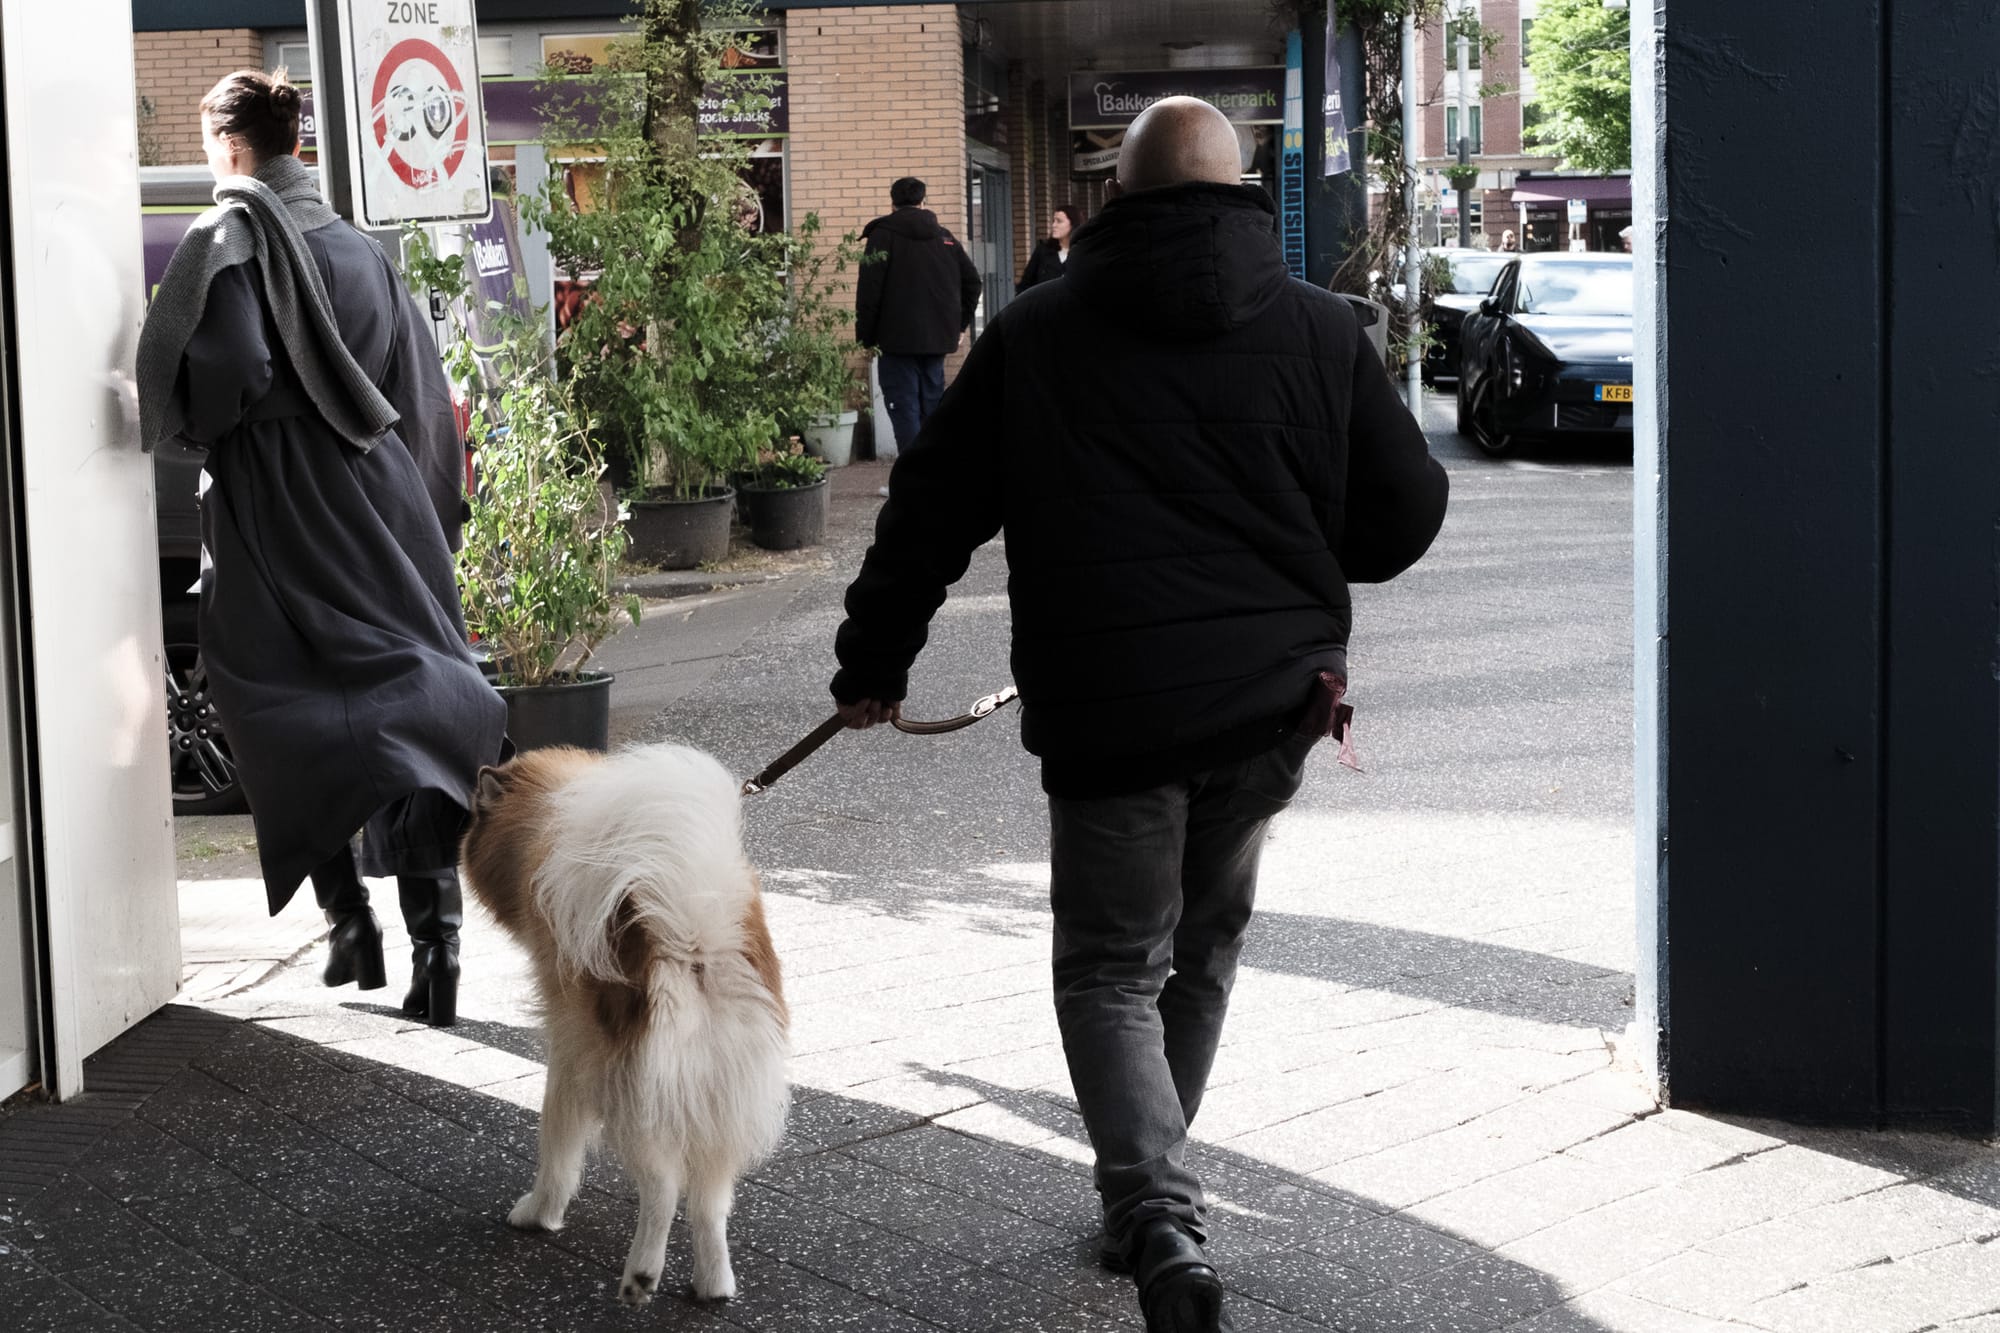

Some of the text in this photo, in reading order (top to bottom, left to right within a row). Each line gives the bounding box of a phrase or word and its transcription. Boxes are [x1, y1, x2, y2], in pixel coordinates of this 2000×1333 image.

[387, 2, 439, 24] ZONE
[732, 109, 770, 124] snacks
[1606, 387, 1632, 399] KFB
